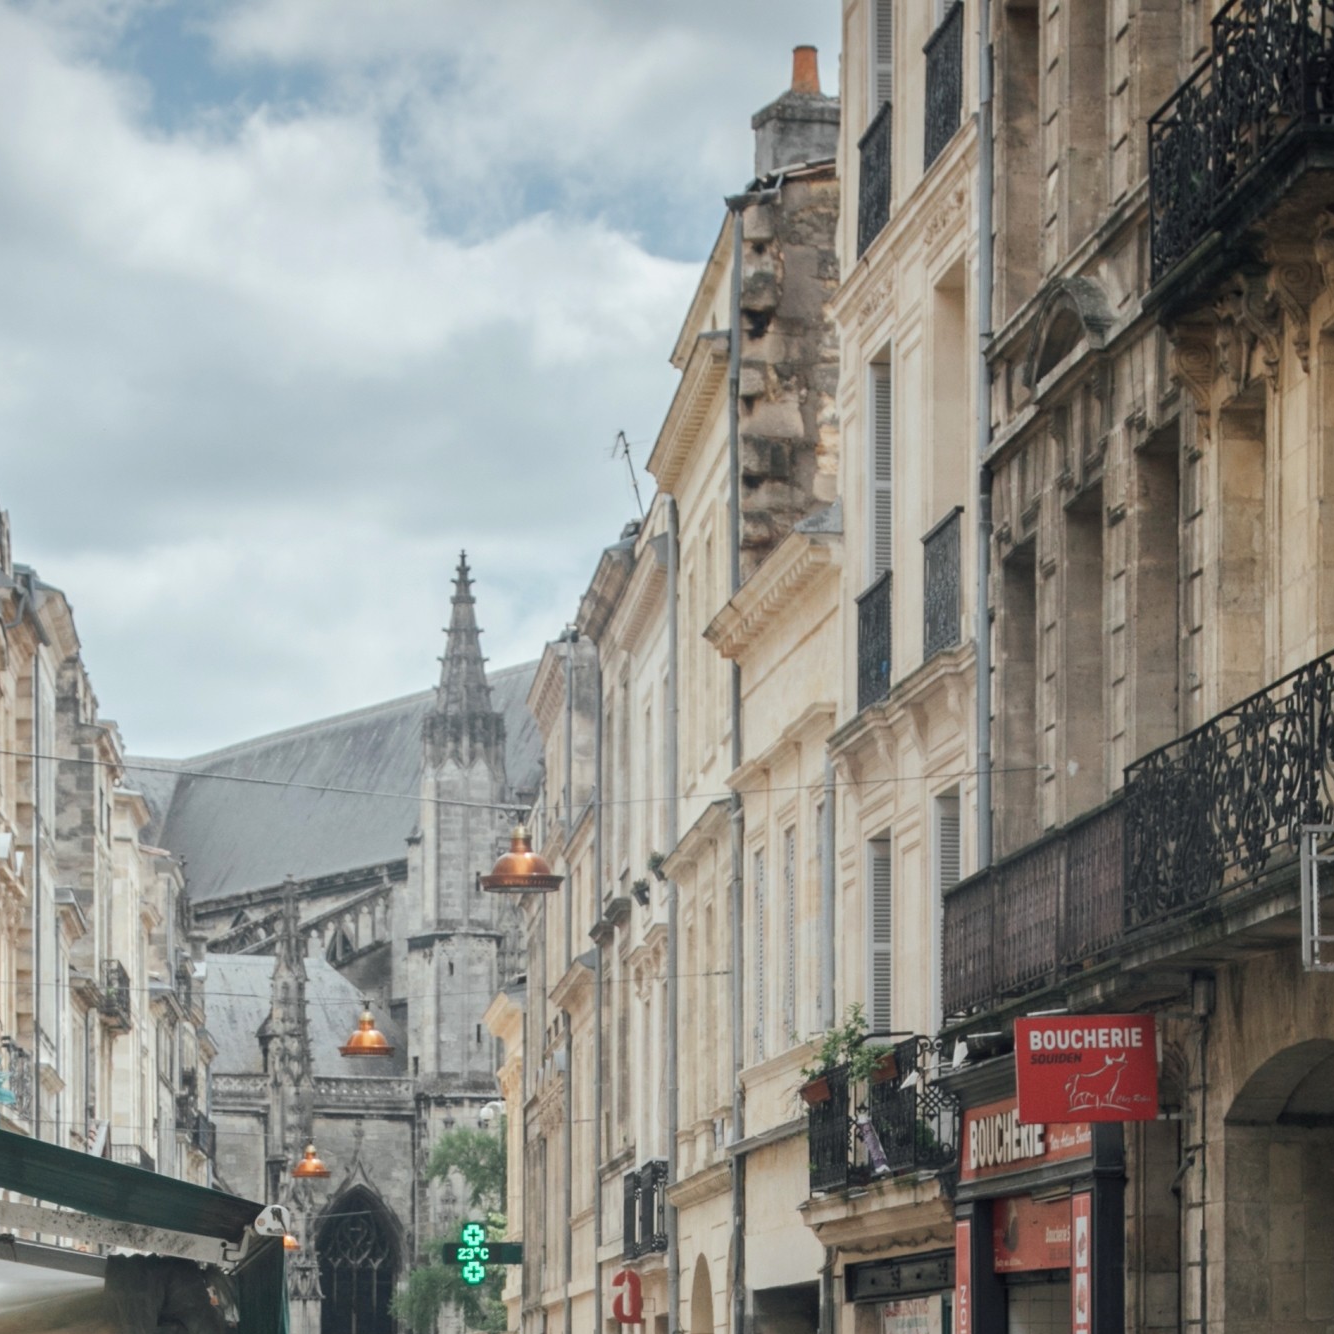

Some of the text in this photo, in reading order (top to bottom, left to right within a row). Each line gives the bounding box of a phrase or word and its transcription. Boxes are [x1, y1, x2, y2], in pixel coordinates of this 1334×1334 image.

[1029, 1027, 1143, 1051] BOUCHERIE
[969, 1108, 1046, 1170] BOUCHERIE
[457, 1247, 489, 1260] 23°C
